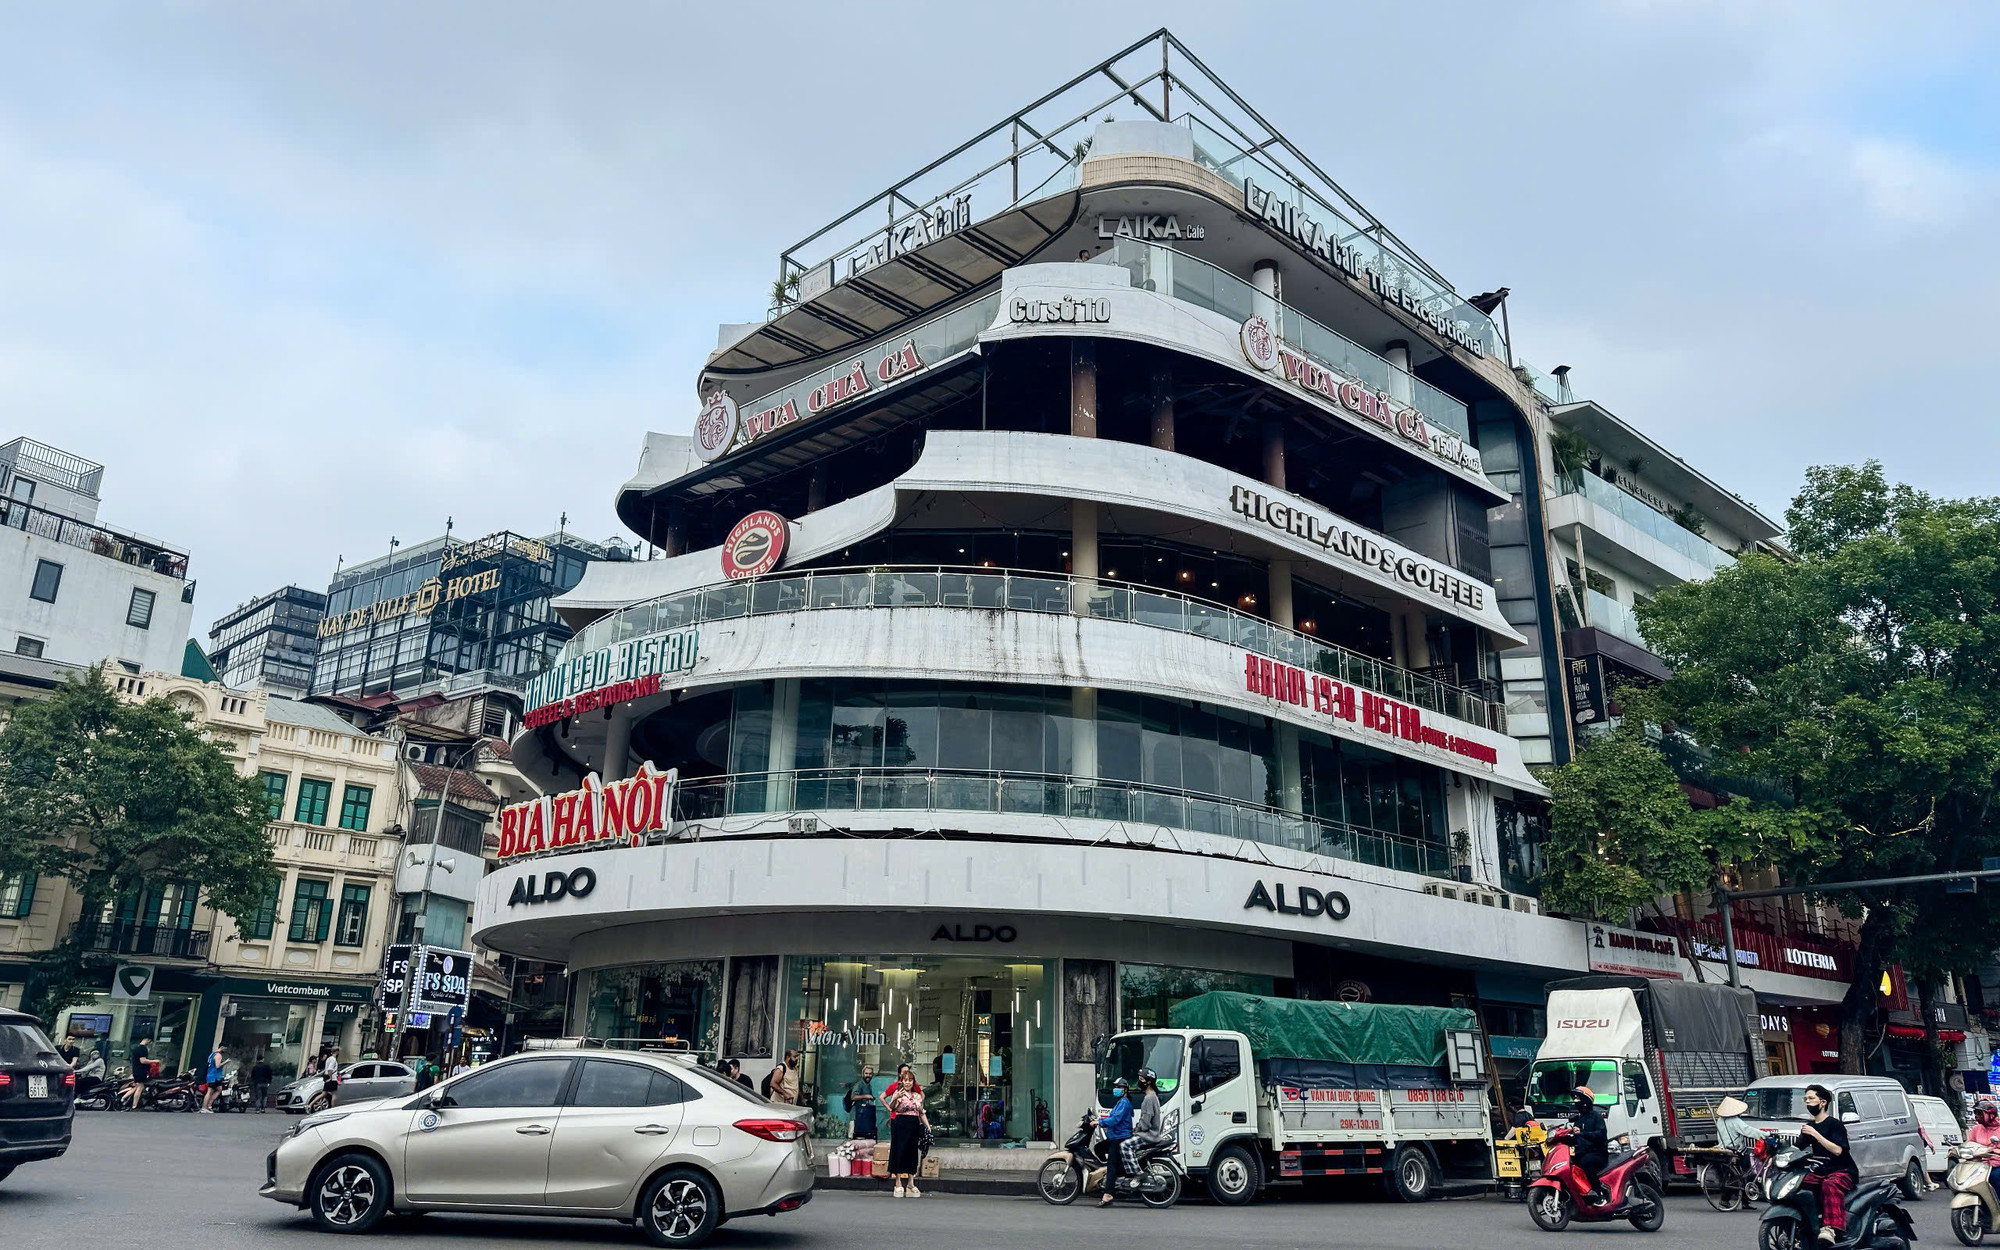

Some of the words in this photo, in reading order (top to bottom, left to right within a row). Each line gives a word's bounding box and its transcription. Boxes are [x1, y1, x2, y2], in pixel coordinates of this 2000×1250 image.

[933, 193, 972, 240] Café
[1098, 214, 1182, 239] LAIKA
[1244, 176, 1330, 260] LAIKA
[1081, 296, 1112, 323] 10
[1367, 267, 1399, 303] The
[1400, 289, 1485, 360] Exceptional
[746, 398, 799, 440] VUA
[807, 360, 873, 414] CHẢ
[877, 338, 922, 383] CÁ
[1280, 349, 1338, 403] VUA
[1339, 381, 1395, 430] CHẢ
[725, 515, 781, 554] HIGHLANDS
[1231, 484, 1398, 574] HIGHLANDS
[1397, 557, 1483, 610] COFFEE
[730, 555, 774, 580] COFFEE
[316, 614, 346, 640] MAY
[348, 606, 369, 631] DE
[371, 593, 411, 622] VILLE
[444, 568, 501, 602] HOTEL
[523, 662, 568, 715] HANOI
[566, 647, 612, 698] 1930
[615, 629, 700, 684] BISTRO
[524, 702, 564, 730] COFFEE
[574, 674, 662, 715] RESTAURANT
[1245, 653, 1309, 709] HANOI
[1311, 675, 1357, 723] 1930
[1361, 690, 1422, 744] BISTRO
[497, 799, 548, 860] BIA
[548, 773, 601, 850] HÀ
[599, 762, 673, 849] NỘI
[507, 866, 597, 907] ALDO
[1243, 879, 1351, 921] ALDO
[930, 924, 1017, 943] ALDO
[392, 960, 409, 974] FS
[1785, 947, 1838, 971] LOTTERIA
[267, 983, 330, 997] Vietcombank
[386, 978, 405, 993] SP
[423, 972, 441, 990] FS
[442, 974, 466, 995] SPA
[333, 1004, 354, 1013] ATM
[1557, 1019, 1610, 1029] ISUZU
[1407, 1088, 1429, 1102] 0856
[1431, 1088, 1447, 1102] 188
[1340, 1119, 1379, 1130] 29K-130.19
